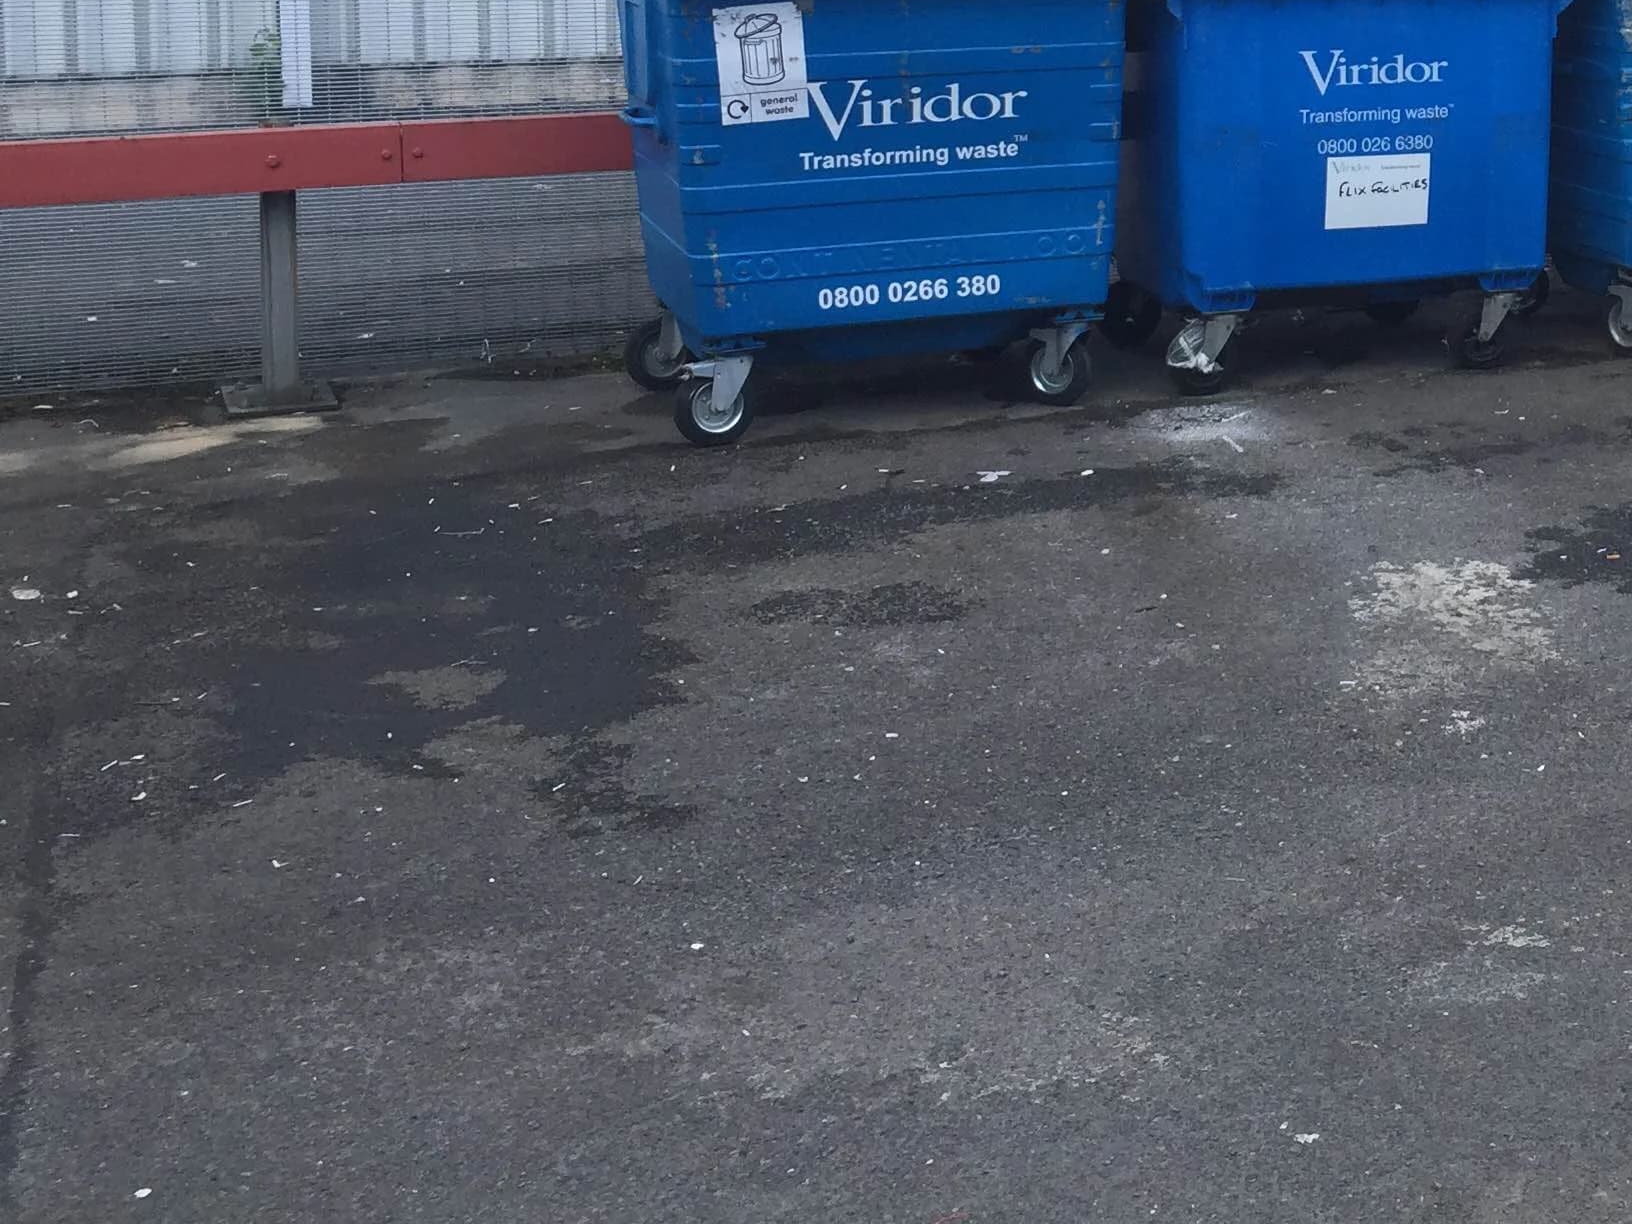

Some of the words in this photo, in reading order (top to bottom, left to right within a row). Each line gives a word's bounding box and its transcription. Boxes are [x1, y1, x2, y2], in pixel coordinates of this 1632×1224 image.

[1298, 49, 1449, 96] Viridor
[760, 92, 798, 107] general
[765, 105, 794, 115] waste
[806, 79, 1029, 141] Viridor
[1299, 107, 1401, 124] Transforming
[1317, 138, 1357, 155] 0800
[1362, 136, 1391, 152] 026
[1395, 134, 1433, 151] 6380
[799, 144, 949, 171] Transforming
[818, 283, 879, 310] 0800
[888, 277, 948, 303] 0266
[957, 274, 1000, 297] 380
